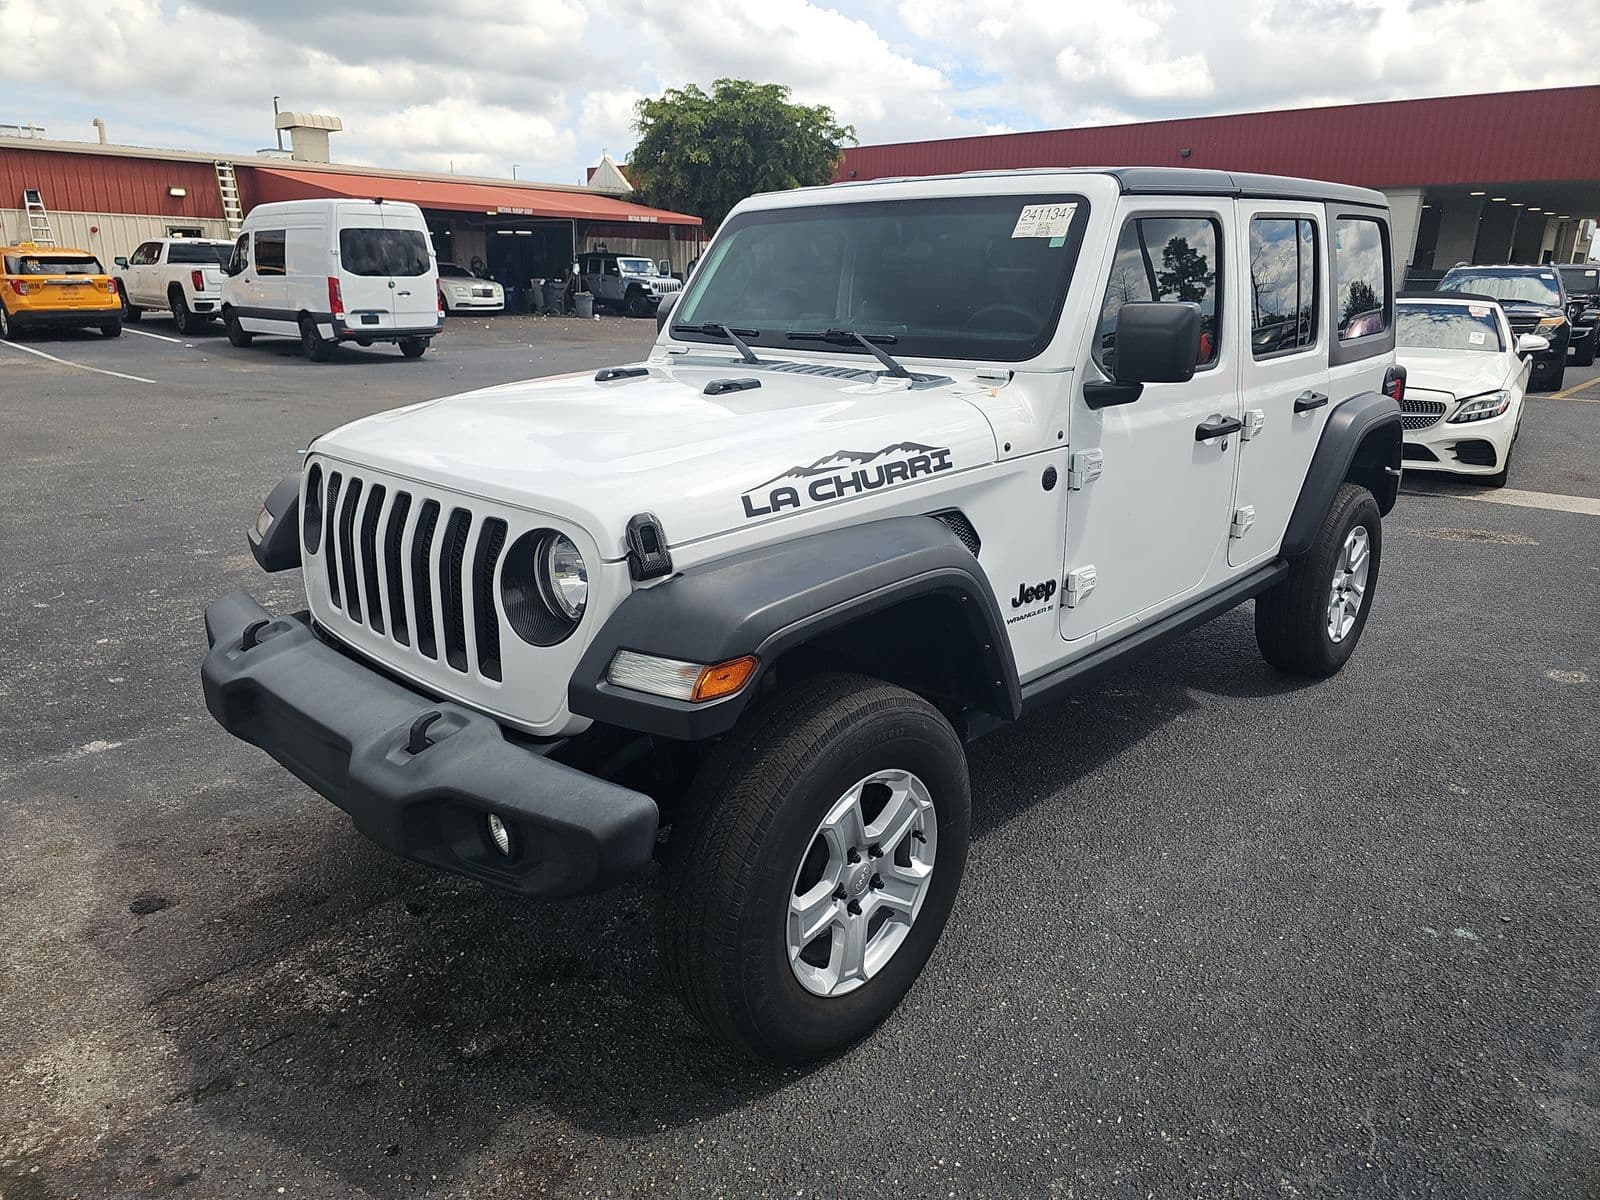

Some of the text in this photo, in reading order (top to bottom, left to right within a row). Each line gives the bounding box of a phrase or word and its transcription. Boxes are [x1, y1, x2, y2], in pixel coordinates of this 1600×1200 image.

[1021, 207, 1077, 221] 2411347
[741, 448, 953, 518] LA CHURRI
[1011, 579, 1057, 608] Jeep
[1006, 607, 1047, 625] WRANGLER
